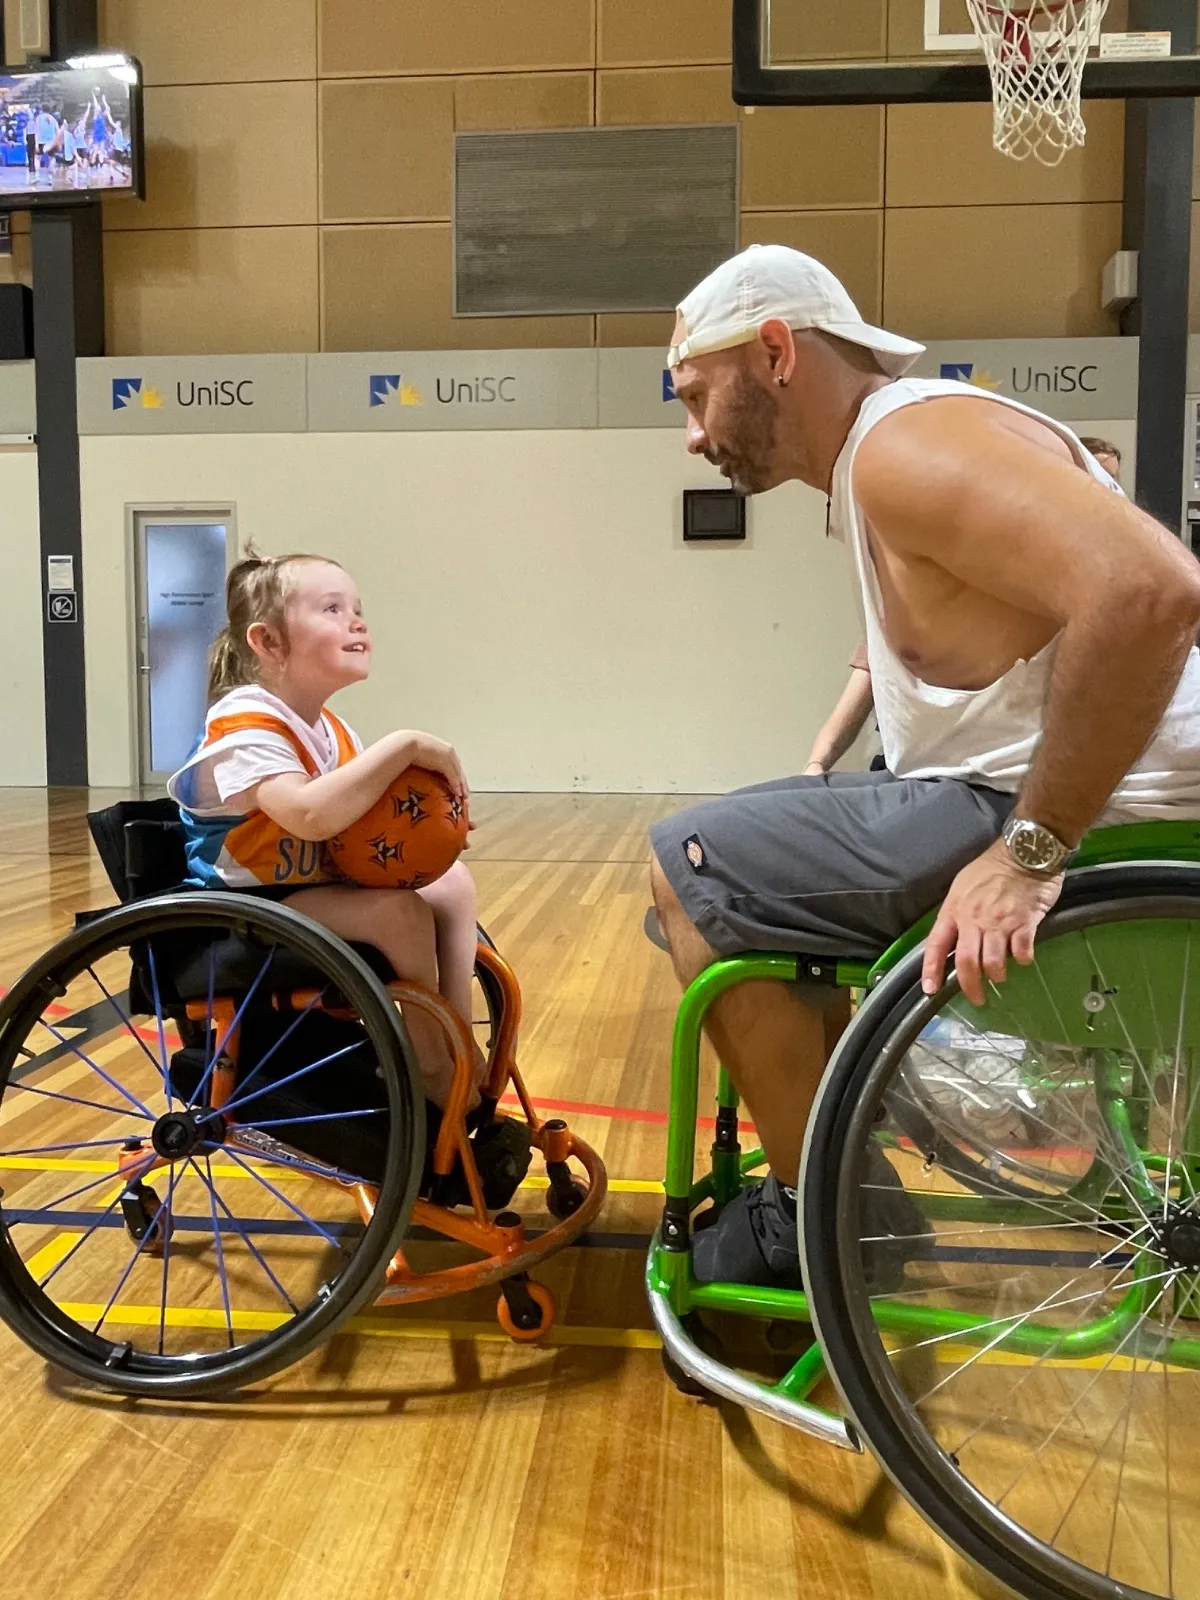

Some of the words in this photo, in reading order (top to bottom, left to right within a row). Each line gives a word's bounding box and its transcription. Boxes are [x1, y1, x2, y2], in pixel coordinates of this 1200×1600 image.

[436, 376, 516, 403] UniSC
[1012, 365, 1097, 393] UniSC
[177, 380, 254, 406] UniSC
[274, 836, 322, 882] SU
